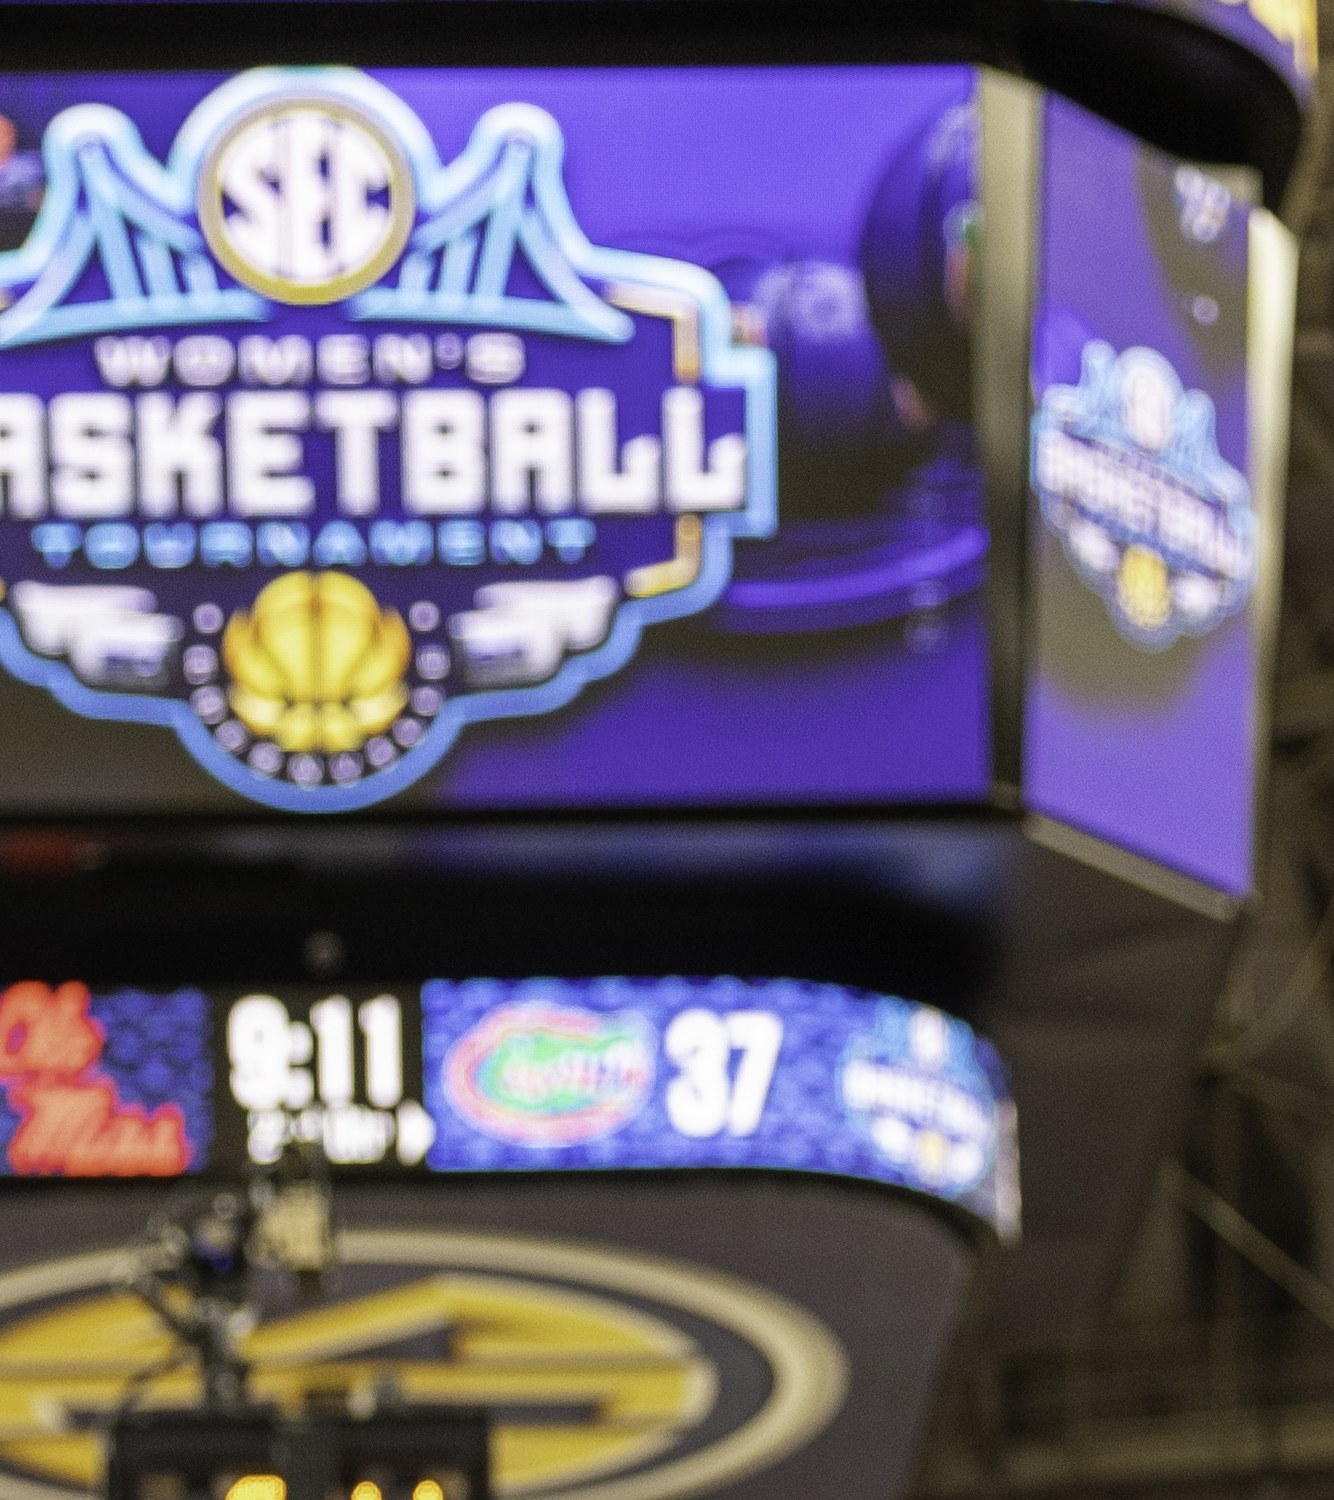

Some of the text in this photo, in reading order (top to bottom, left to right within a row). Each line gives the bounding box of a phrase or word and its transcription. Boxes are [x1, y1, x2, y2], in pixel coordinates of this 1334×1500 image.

[95, 335, 525, 388] WOMEN'S
[32, 519, 596, 570] TOURNAMENT
[667, 1008, 784, 1138] 37
